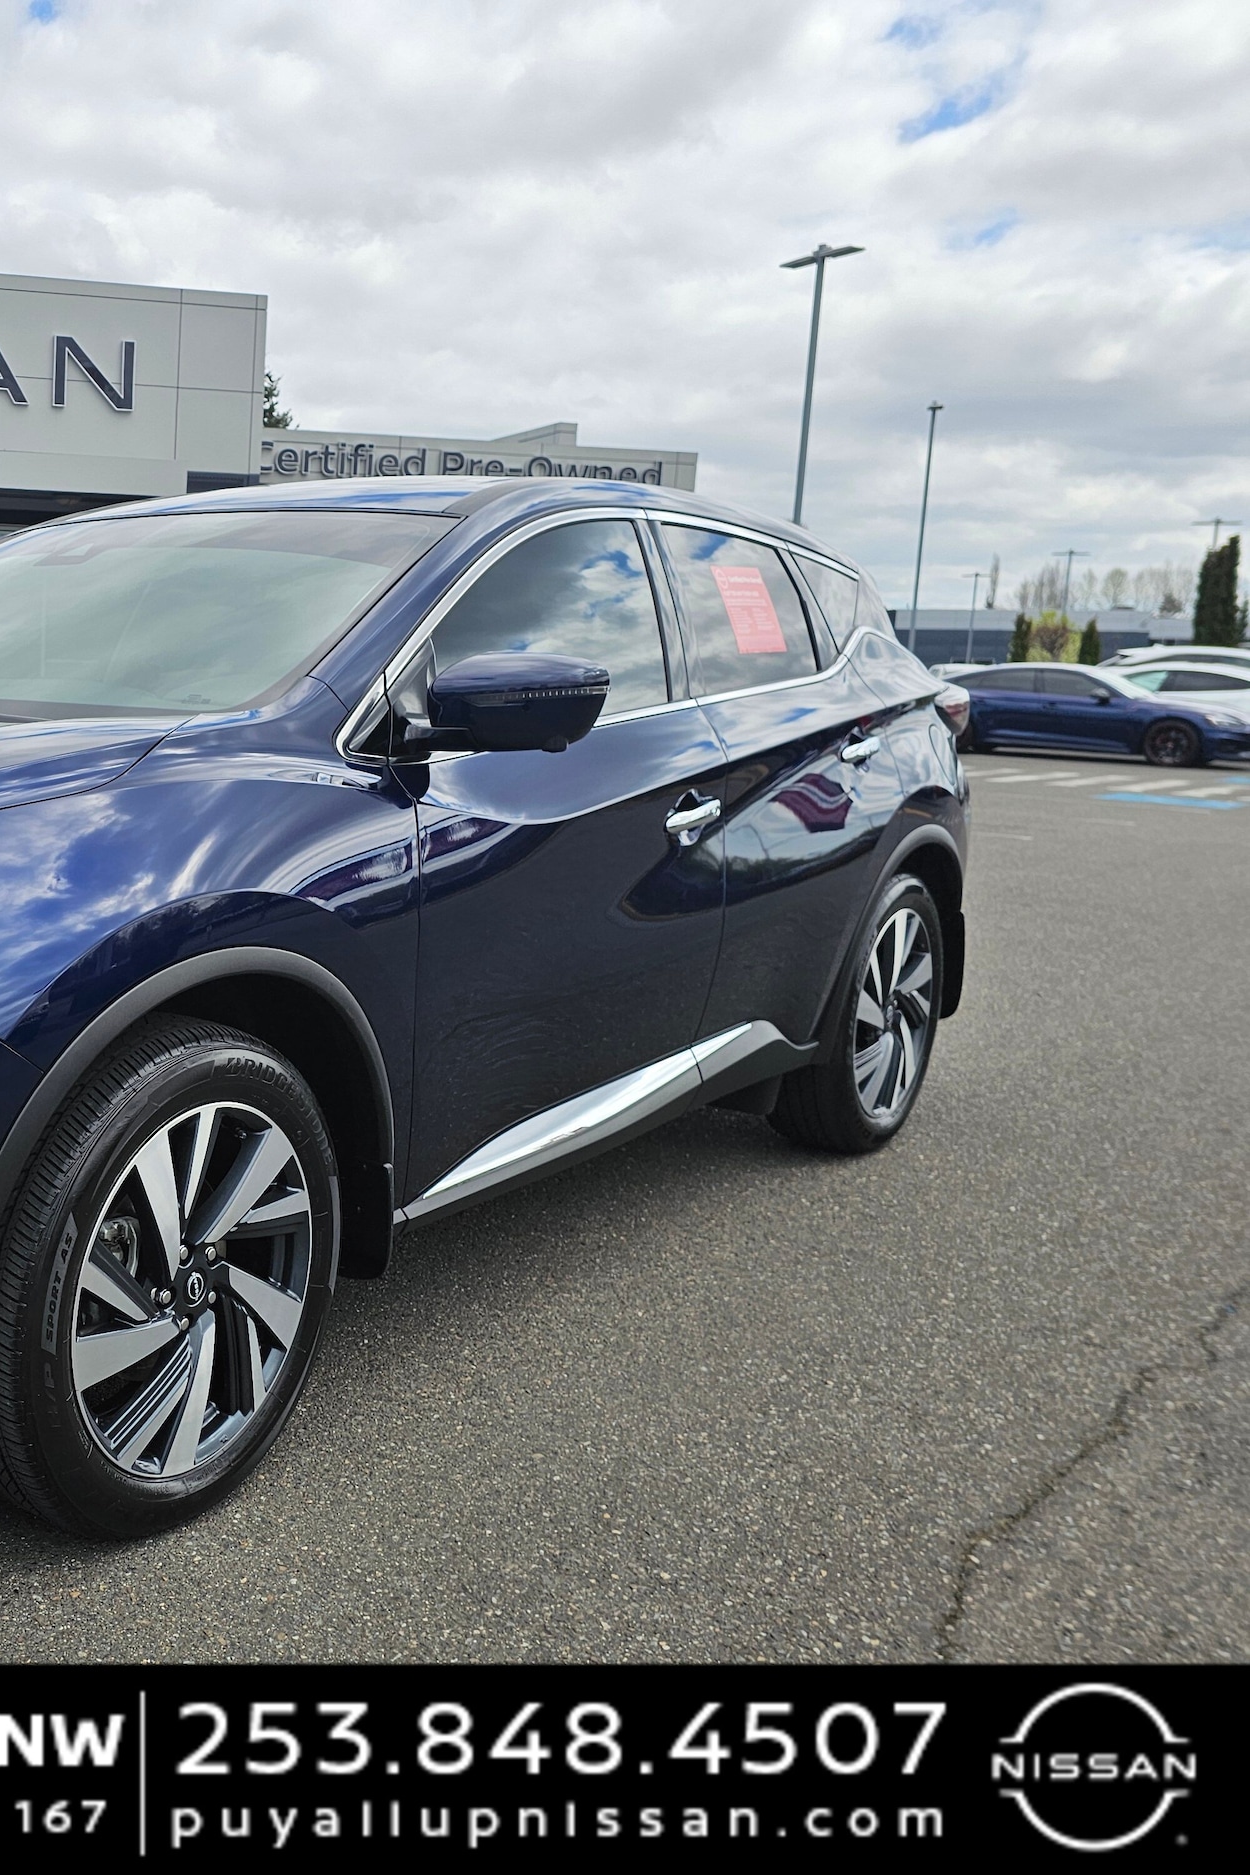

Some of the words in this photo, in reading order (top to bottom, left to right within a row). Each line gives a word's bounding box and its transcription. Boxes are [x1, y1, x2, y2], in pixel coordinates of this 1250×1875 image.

[442, 451, 664, 486] Pre-Owned
[45, 1270, 61, 1343] SPORT
[60, 1232, 73, 1264] AS
